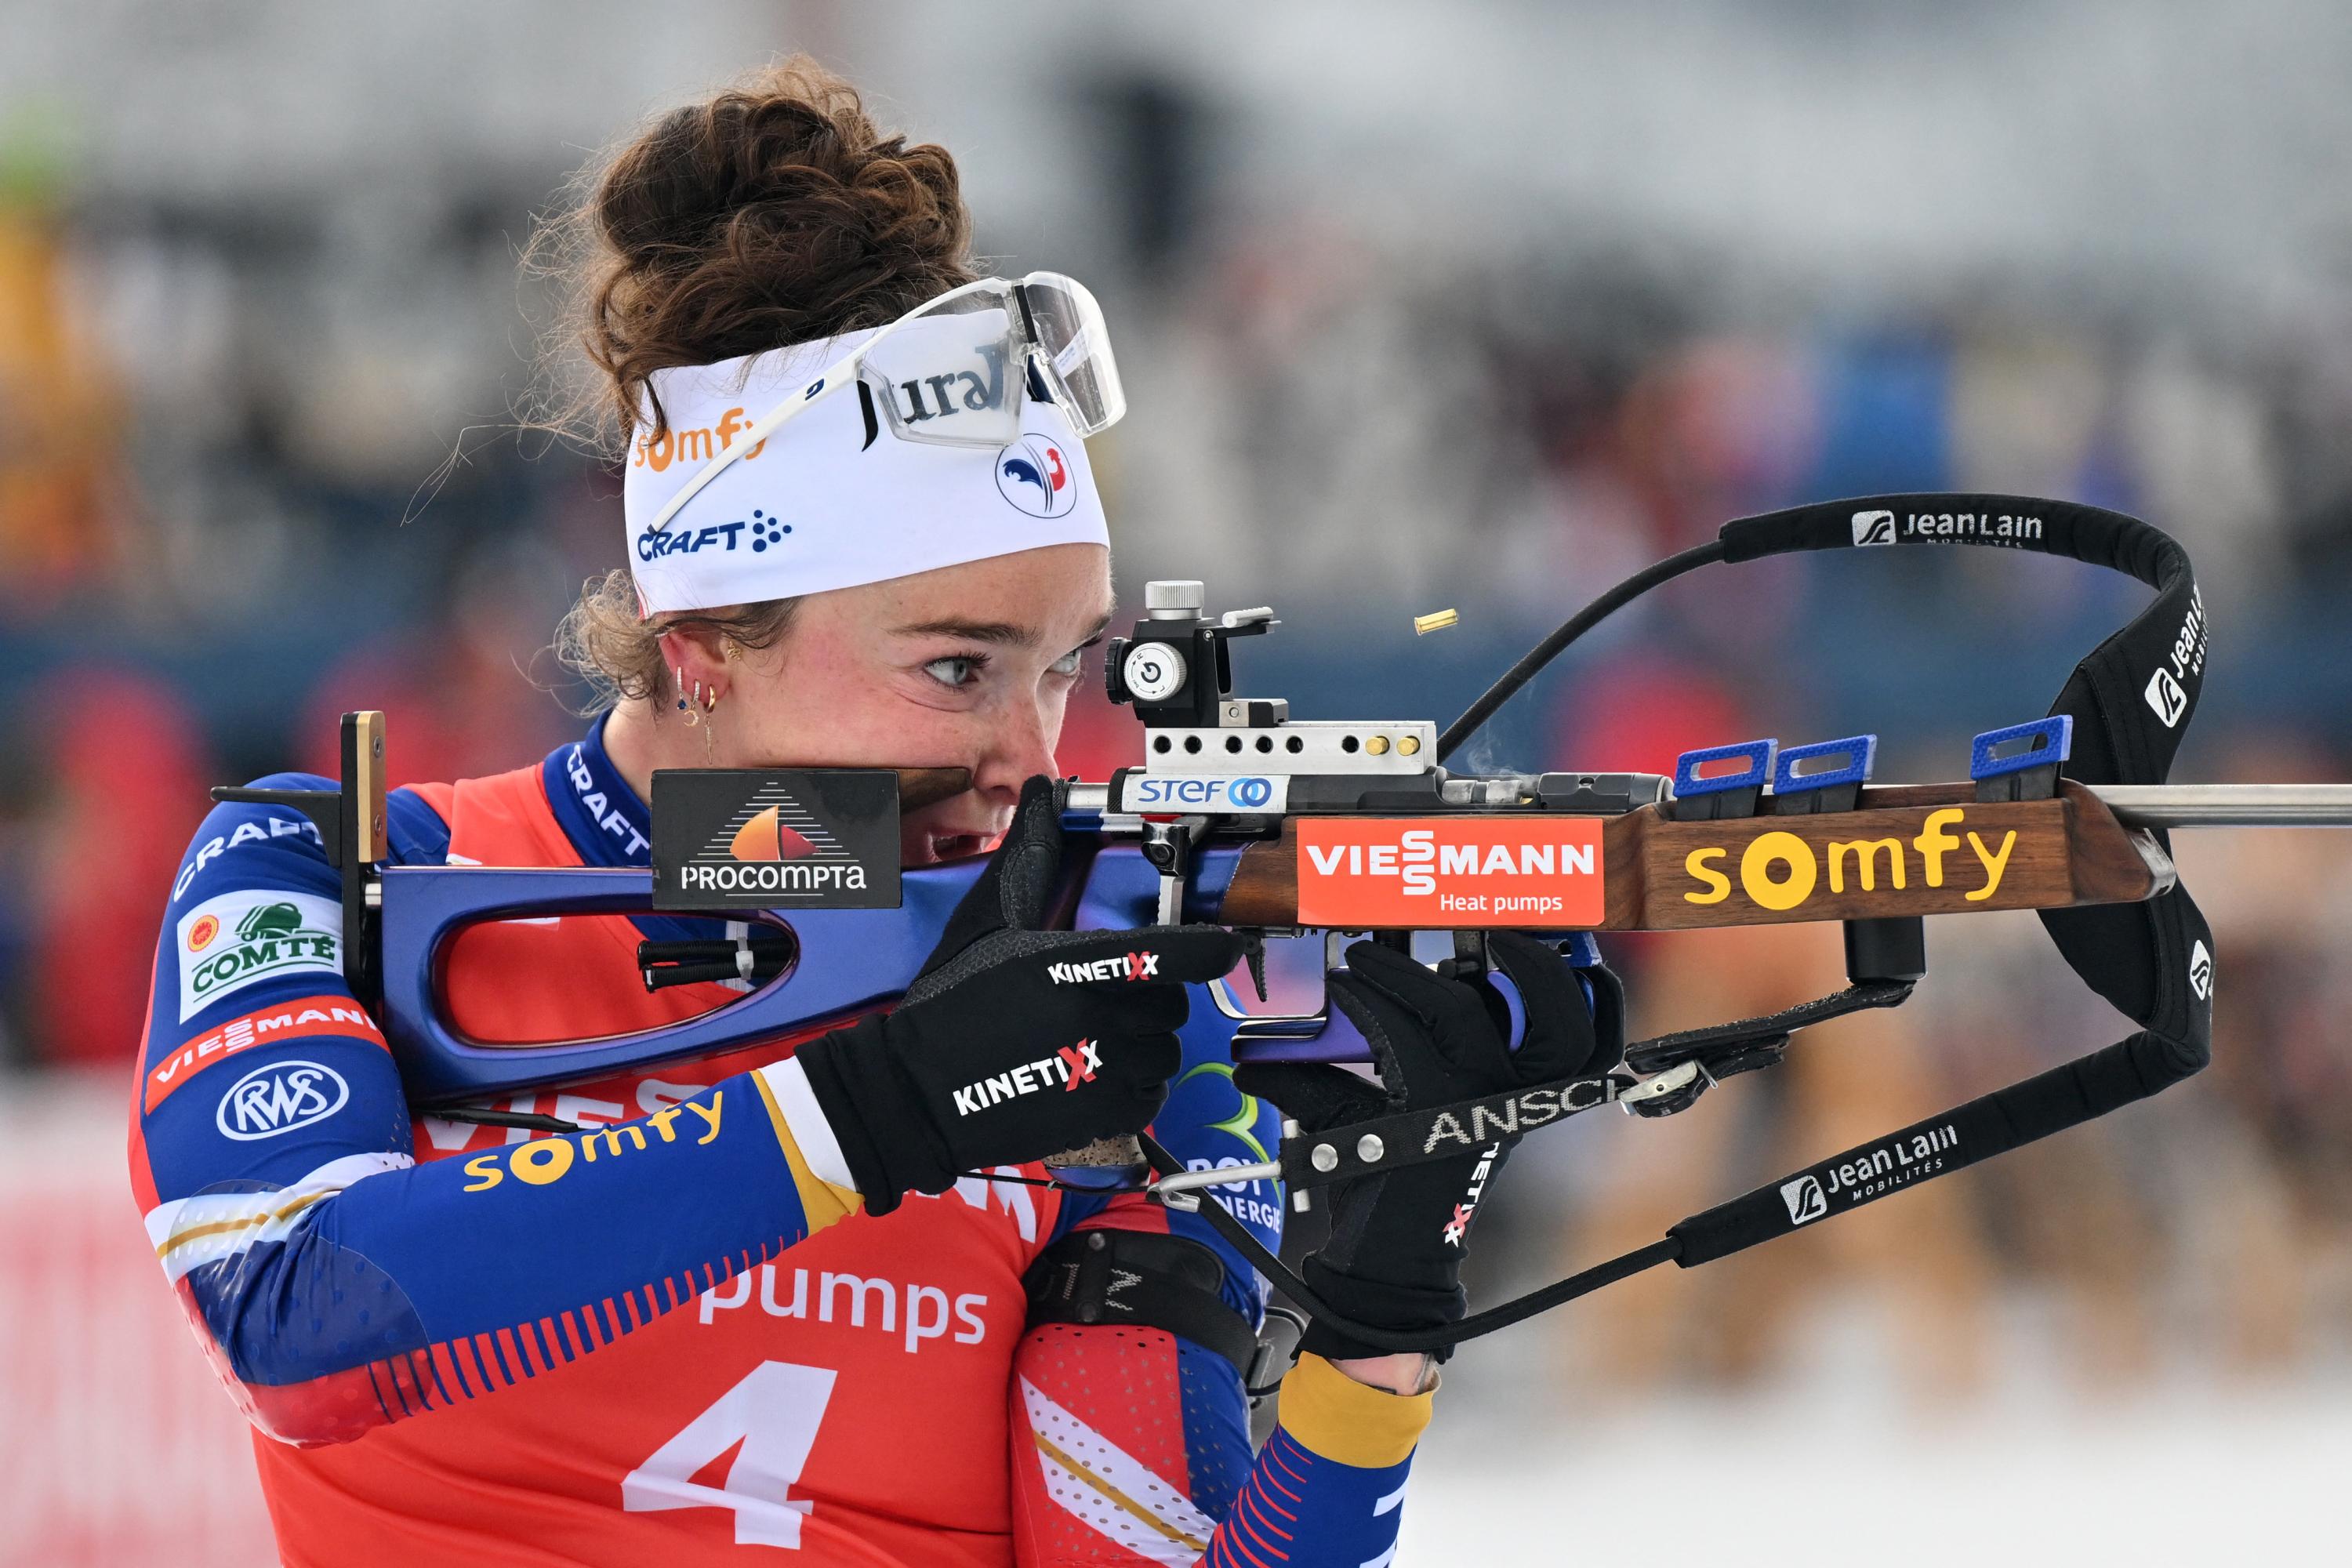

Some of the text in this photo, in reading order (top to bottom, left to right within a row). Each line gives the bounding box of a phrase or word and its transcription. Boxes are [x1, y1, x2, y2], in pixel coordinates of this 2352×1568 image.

[637, 521, 745, 561] CRAFT
[1904, 514, 2042, 539] Jean Lain
[2170, 611, 2201, 679] Jean
[567, 745, 651, 856] CRAFT
[1306, 831, 1595, 895] VIESSMANN
[1684, 808, 2016, 910] somfy
[1440, 894, 1563, 914] Heat pumps
[193, 935, 336, 993] COMTÉ
[1048, 952, 1159, 985] KINETIXX
[234, 1069, 328, 1131] RWS
[953, 1038, 1103, 1116] KINETIXX
[463, 1091, 723, 1192] somfy
[1828, 1149, 1893, 1193] Jean
[1211, 1195, 1281, 1234] NERGIE
[699, 1264, 987, 1353] pumps
[621, 1359, 837, 1549] 4
